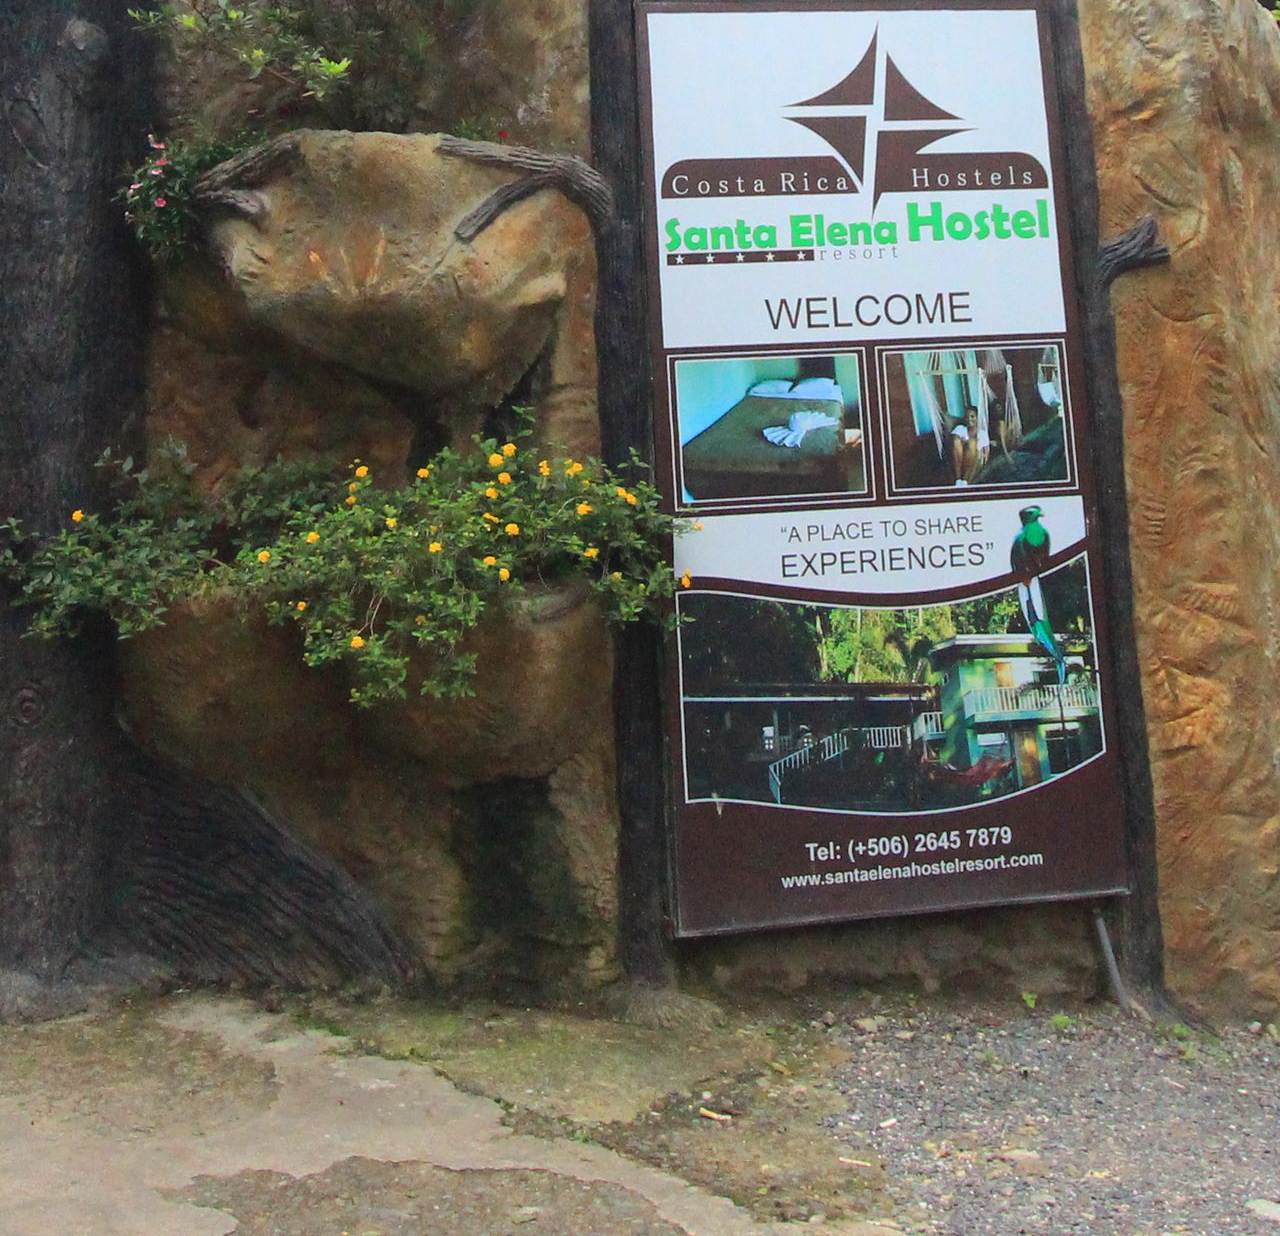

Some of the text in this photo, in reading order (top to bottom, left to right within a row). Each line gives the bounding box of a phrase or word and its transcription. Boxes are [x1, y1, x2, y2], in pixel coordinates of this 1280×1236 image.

[672, 166, 1033, 195] Costa Rica Hostels
[665, 199, 1050, 252] Santa Elena Hostel
[820, 246, 899, 260] resort
[764, 292, 973, 330] WELCOME
[781, 515, 983, 543] “A PLACE TO SHARE
[781, 542, 994, 578] EXPERIENCES”
[805, 826, 1013, 863] Tel: (+506) 2645 7879
[781, 851, 1044, 889] www.santaelenahostelresort.com
